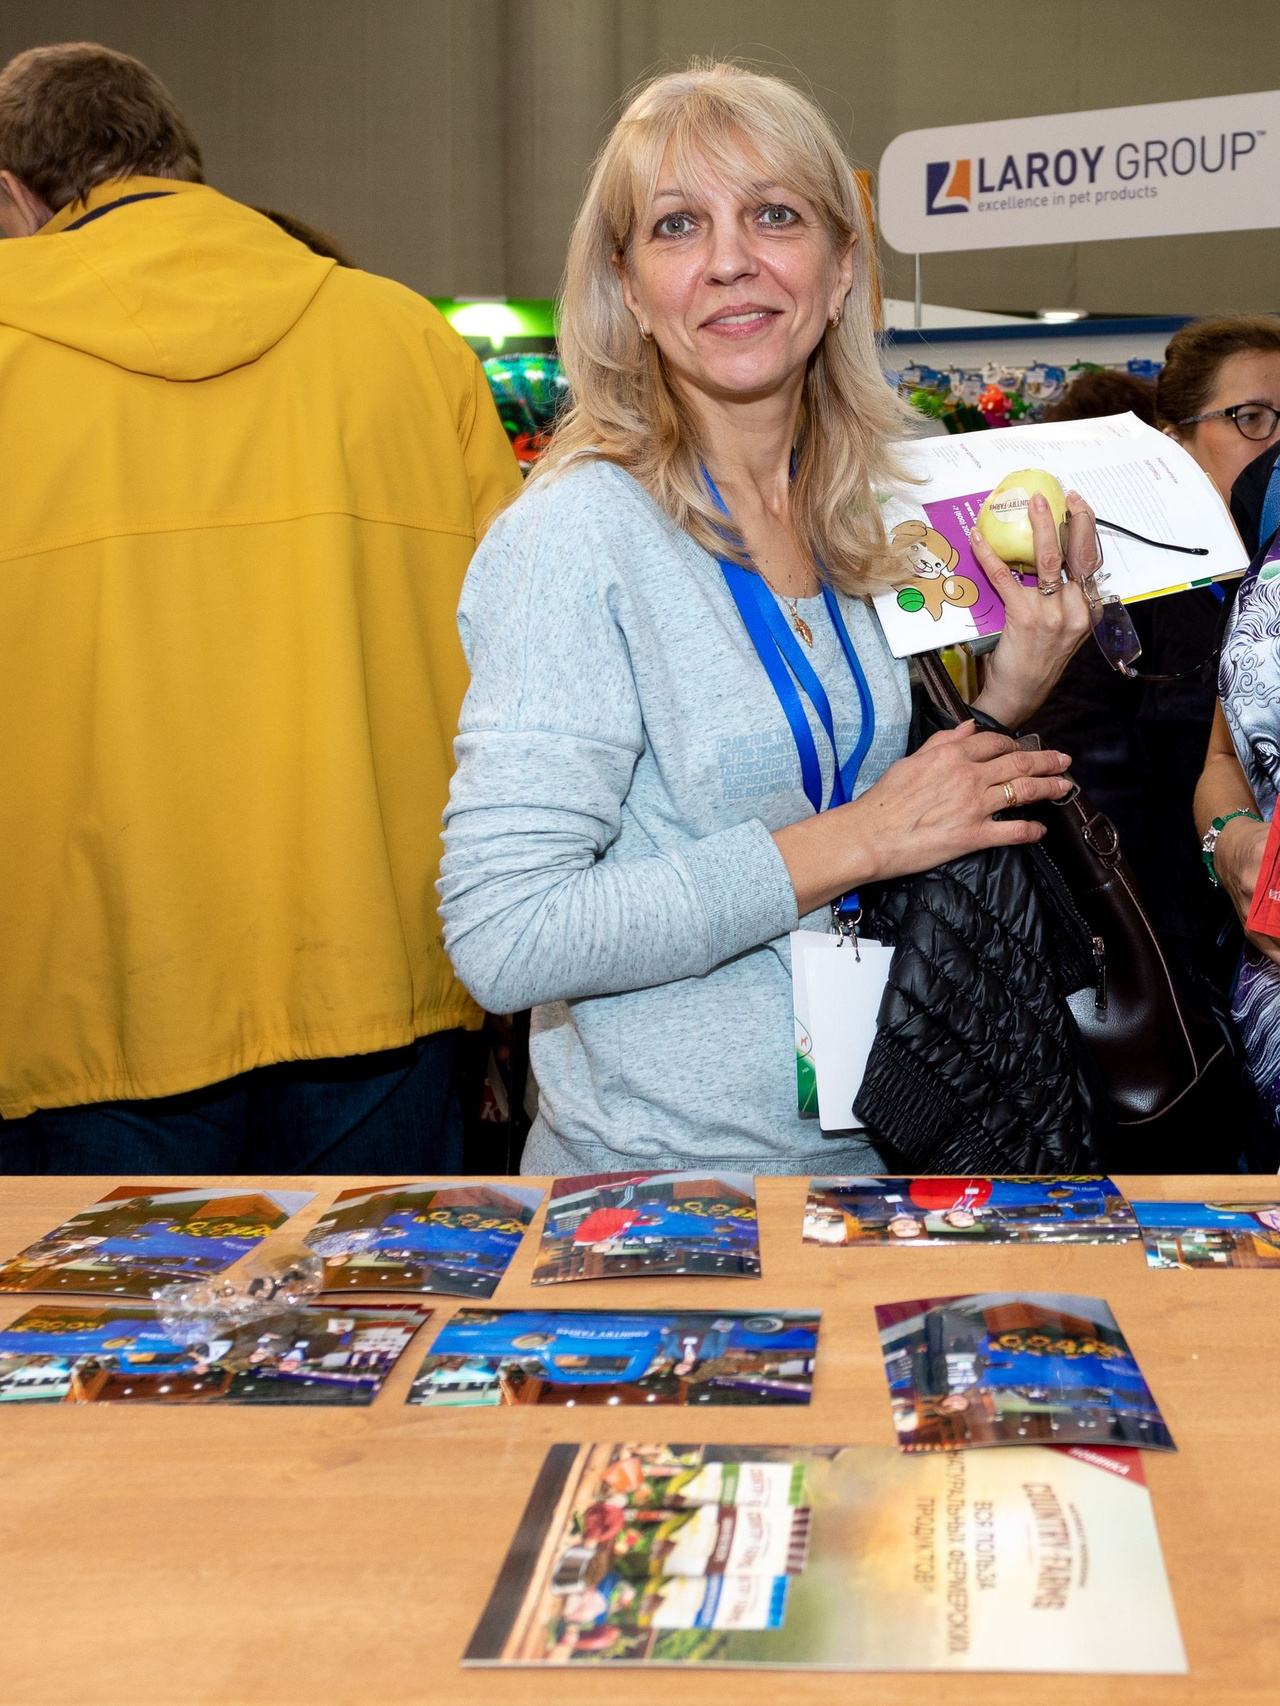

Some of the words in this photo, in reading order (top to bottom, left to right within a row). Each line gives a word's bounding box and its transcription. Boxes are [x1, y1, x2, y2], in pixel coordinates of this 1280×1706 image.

[978, 145, 1105, 193] LAROY
[978, 196, 1048, 212] excellence
[1052, 193, 1065, 205] in
[1069, 191, 1090, 207] pet
[1095, 185, 1158, 206] products
[1009, 500, 1029, 508] UNTRY
[973, 1500, 994, 1528] ВСЯ
[1022, 1483, 1072, 1551] COUNTRY
[975, 1530, 997, 1591] ПОЛЬЗА
[1033, 1555, 1073, 1610] FARMS
